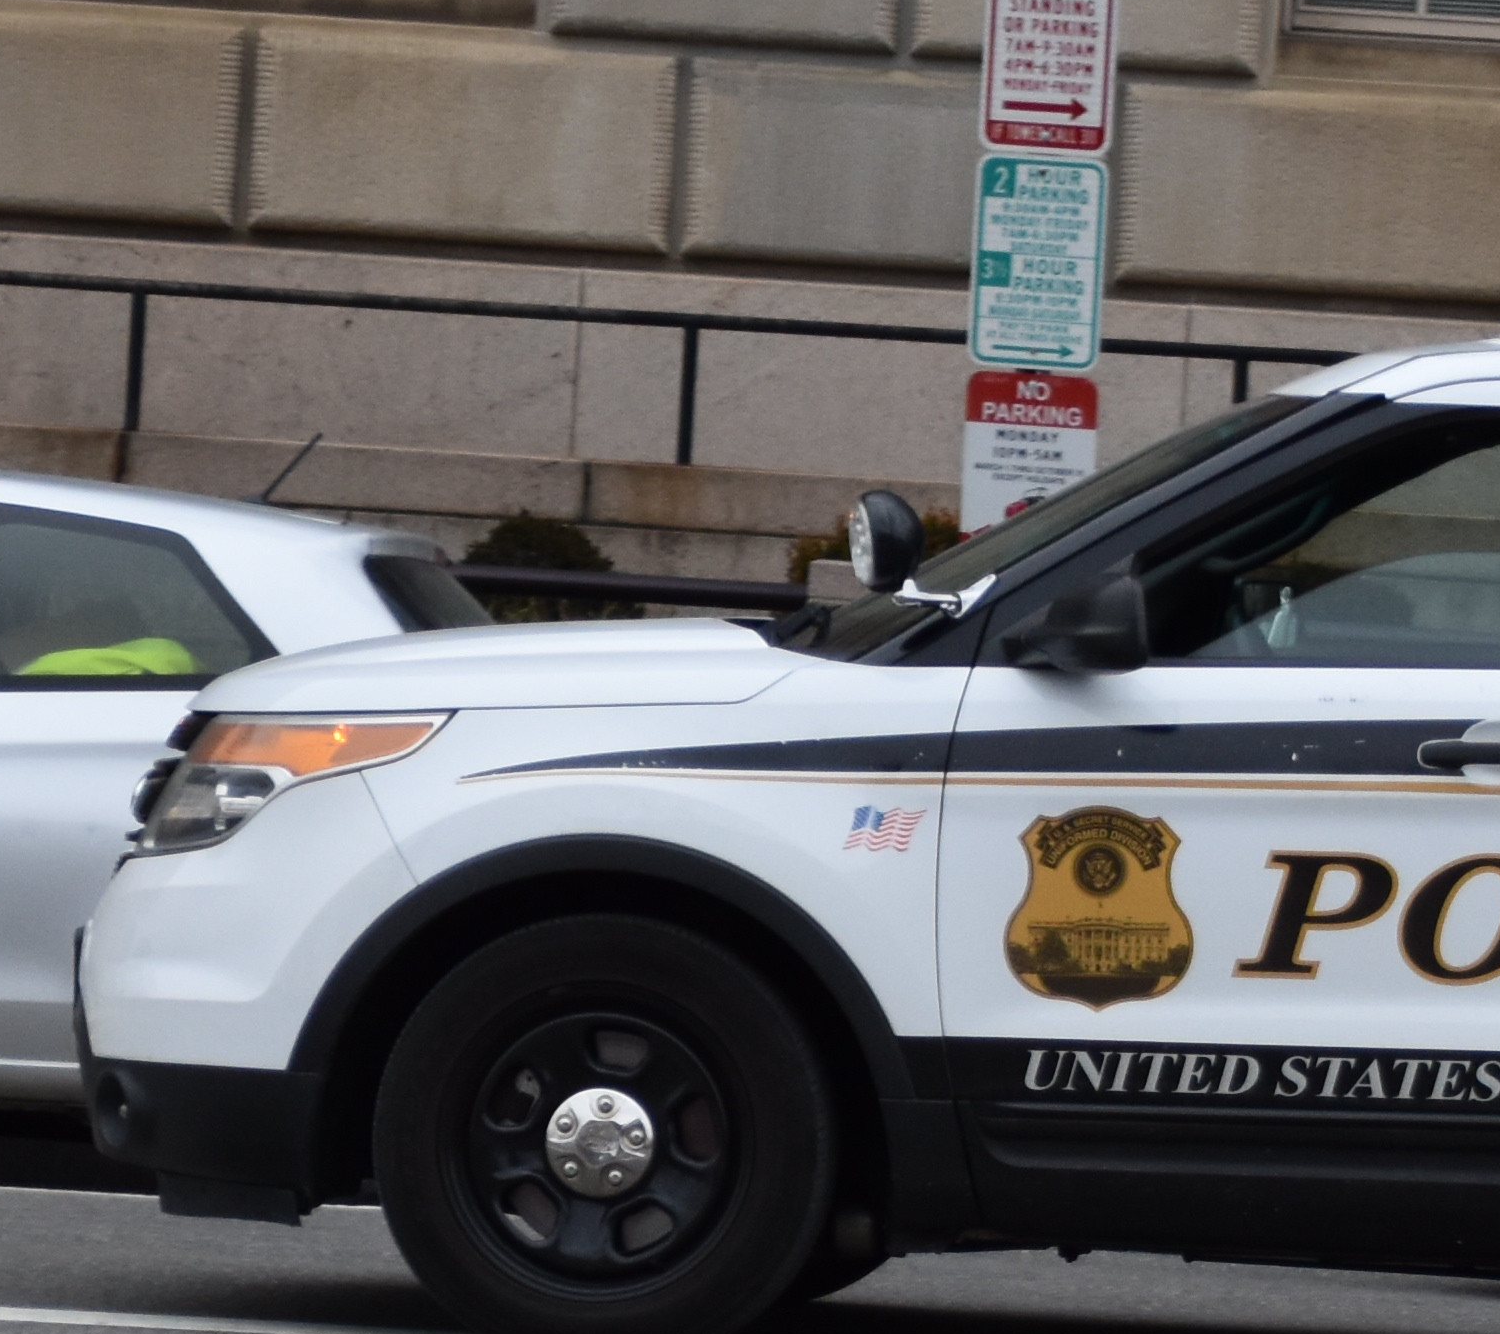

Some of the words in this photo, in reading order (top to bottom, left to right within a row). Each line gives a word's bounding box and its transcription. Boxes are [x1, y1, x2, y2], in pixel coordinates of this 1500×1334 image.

[1004, 17, 1023, 33] OR
[1031, 18, 1098, 38] PARKING
[993, 167, 1009, 193] 2
[1027, 168, 1081, 185] HOUR
[1019, 185, 1088, 205] PARKING
[1023, 258, 1077, 276] HOUR
[1013, 276, 1084, 296] PARKING
[1015, 380, 1051, 401] NO
[981, 401, 1083, 427] PARKING
[996, 429, 1059, 443] MONDAY
[1046, 827, 1108, 866] UNIFORMED
[1109, 830, 1152, 866] DIVISION
[1023, 1049, 1260, 1096] UNITED
